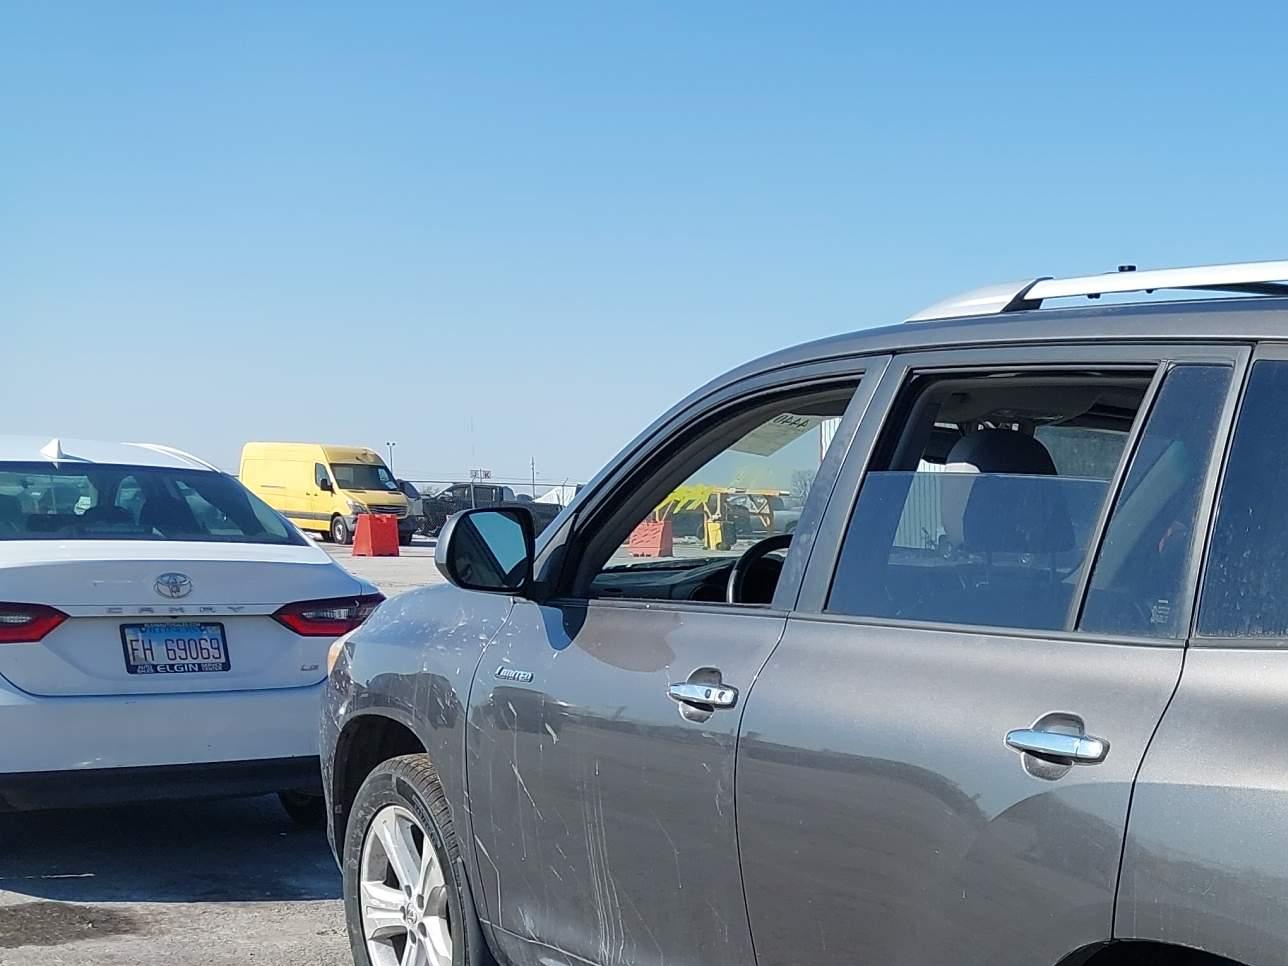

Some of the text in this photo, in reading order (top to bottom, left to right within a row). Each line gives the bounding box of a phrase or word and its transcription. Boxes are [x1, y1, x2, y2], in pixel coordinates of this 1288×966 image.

[106, 606, 244, 614] CAMRY
[129, 638, 223, 662] FH 69069
[157, 663, 199, 673] ELGIN
